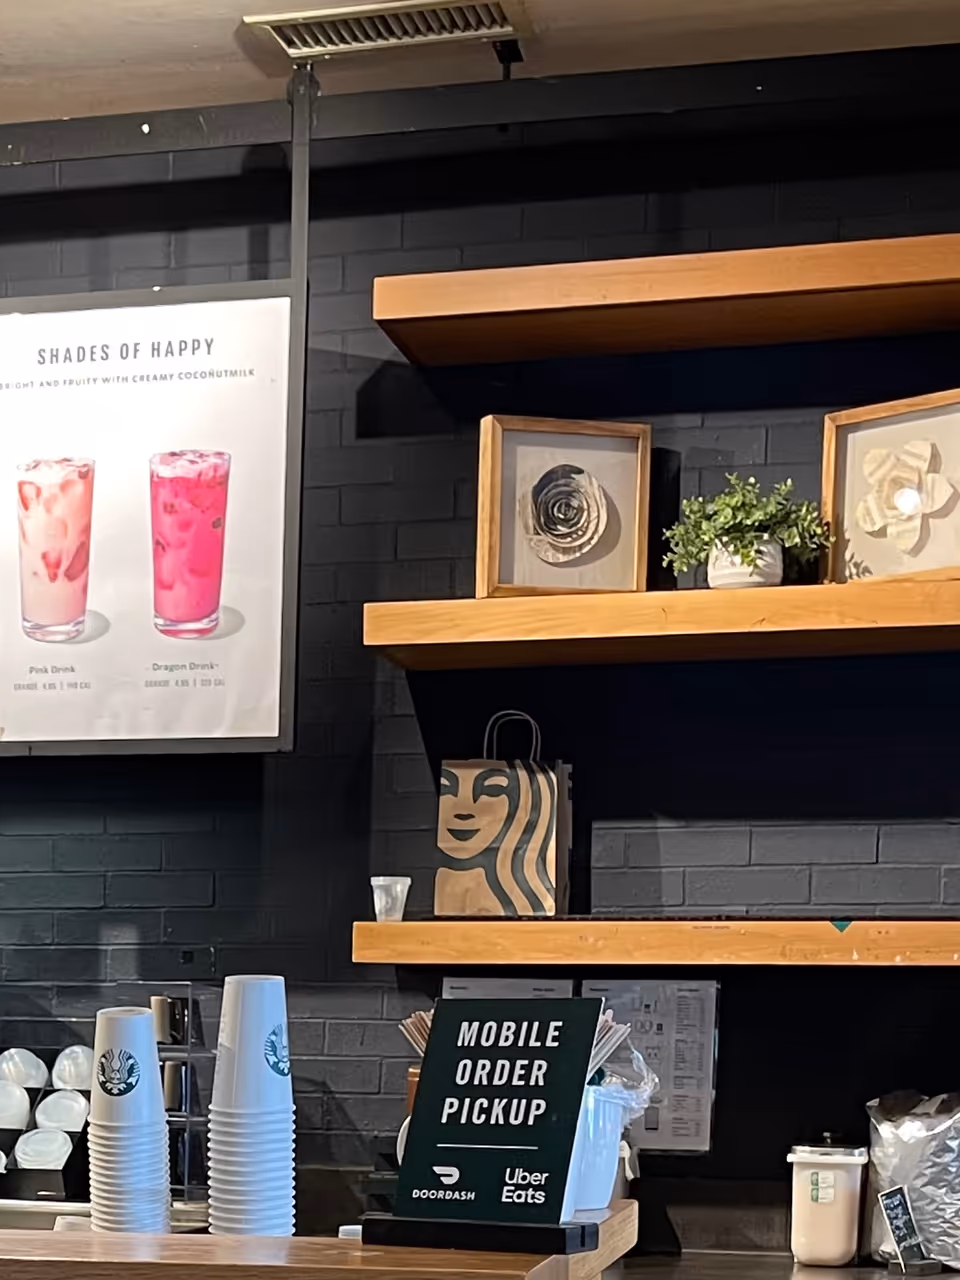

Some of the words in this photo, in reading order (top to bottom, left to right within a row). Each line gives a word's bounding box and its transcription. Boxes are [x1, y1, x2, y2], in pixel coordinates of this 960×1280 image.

[37, 344, 110, 365] SHADES
[119, 342, 141, 360] OF
[151, 337, 215, 358] HAPPY
[39, 380, 60, 389] AND
[101, 375, 130, 385] WITH
[132, 373, 175, 384] CREAMY
[29, 665, 49, 674] Pink
[50, 664, 76, 674] Drink
[152, 662, 187, 673] Dragon
[457, 1020, 563, 1047] MOBILE
[455, 1058, 548, 1086] ORDER
[440, 1097, 547, 1126] PICKUP
[504, 1167, 549, 1186] Uber
[411, 1188, 476, 1201] DOORDASH
[501, 1186, 546, 1204] Eats
